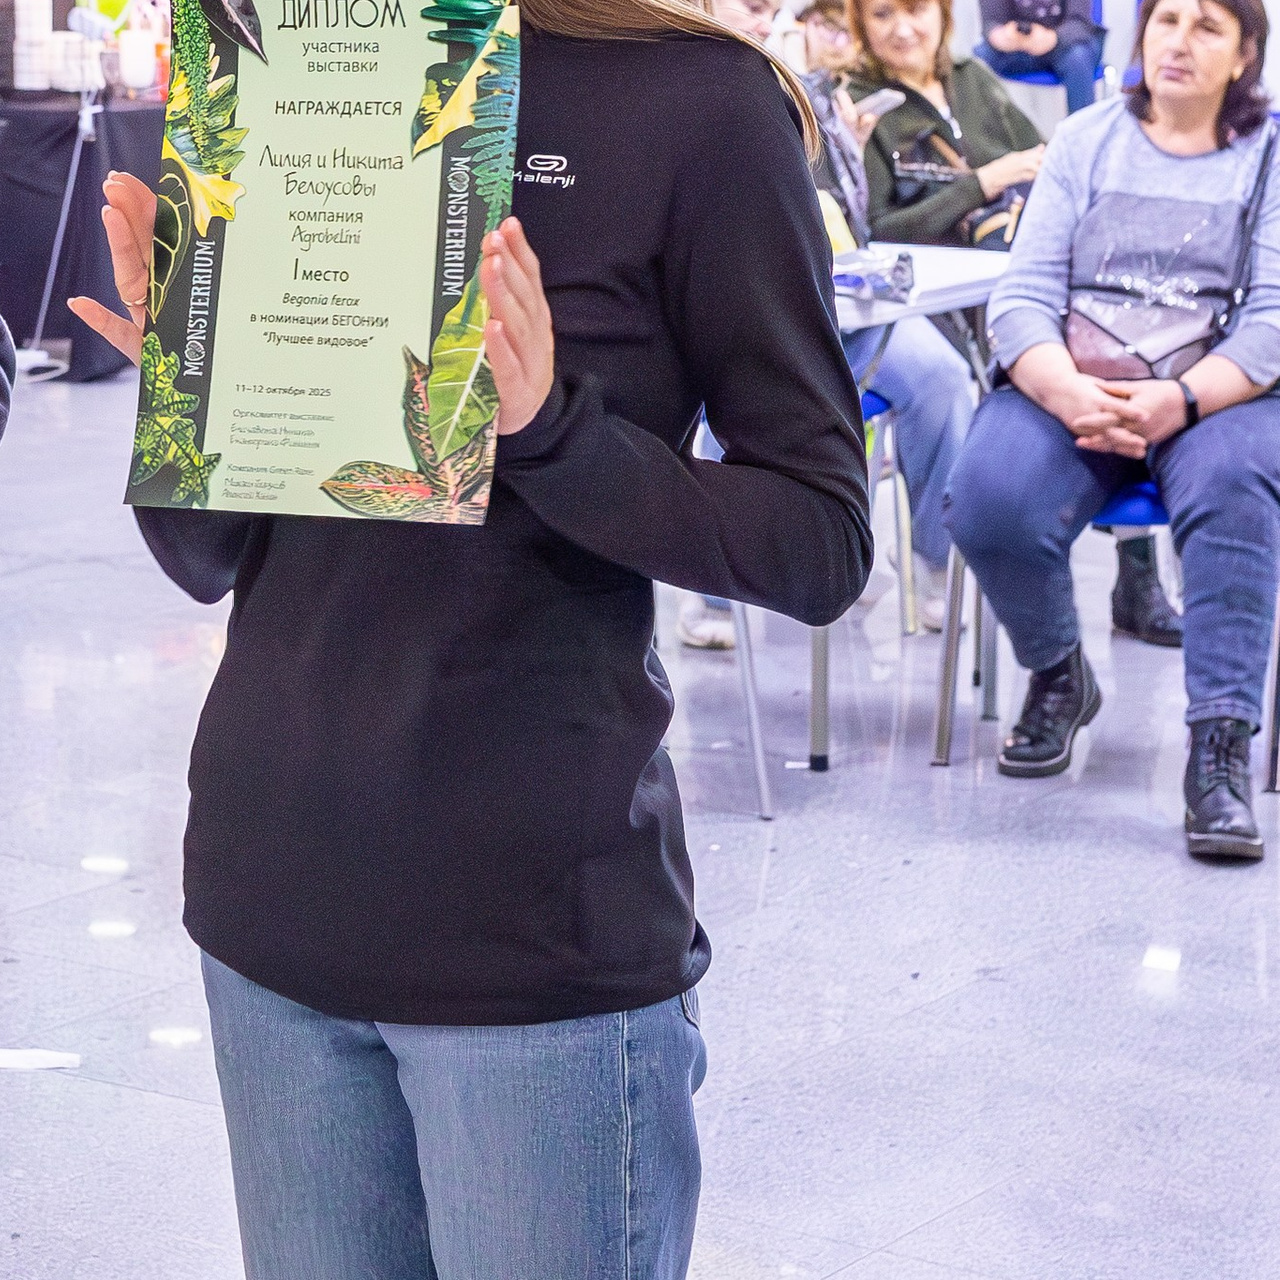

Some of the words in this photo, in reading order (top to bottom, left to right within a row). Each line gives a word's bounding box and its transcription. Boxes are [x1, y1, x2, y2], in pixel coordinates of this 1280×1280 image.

[302, 41, 380, 57] участника
[307, 61, 378, 73] выставки
[274, 100, 403, 118] НАГРАЖДАЕТСЯ
[258, 144, 312, 169] Лилия
[317, 154, 327, 169] и
[332, 147, 405, 170] Никита
[283, 171, 377, 207] Белоусовы
[288, 210, 364, 224] компания
[301, 269, 350, 282] место
[282, 292, 329, 307] Begonia
[250, 313, 257, 322] в
[260, 313, 329, 326] номинации
[331, 314, 390, 328] БЕГОНИИ
